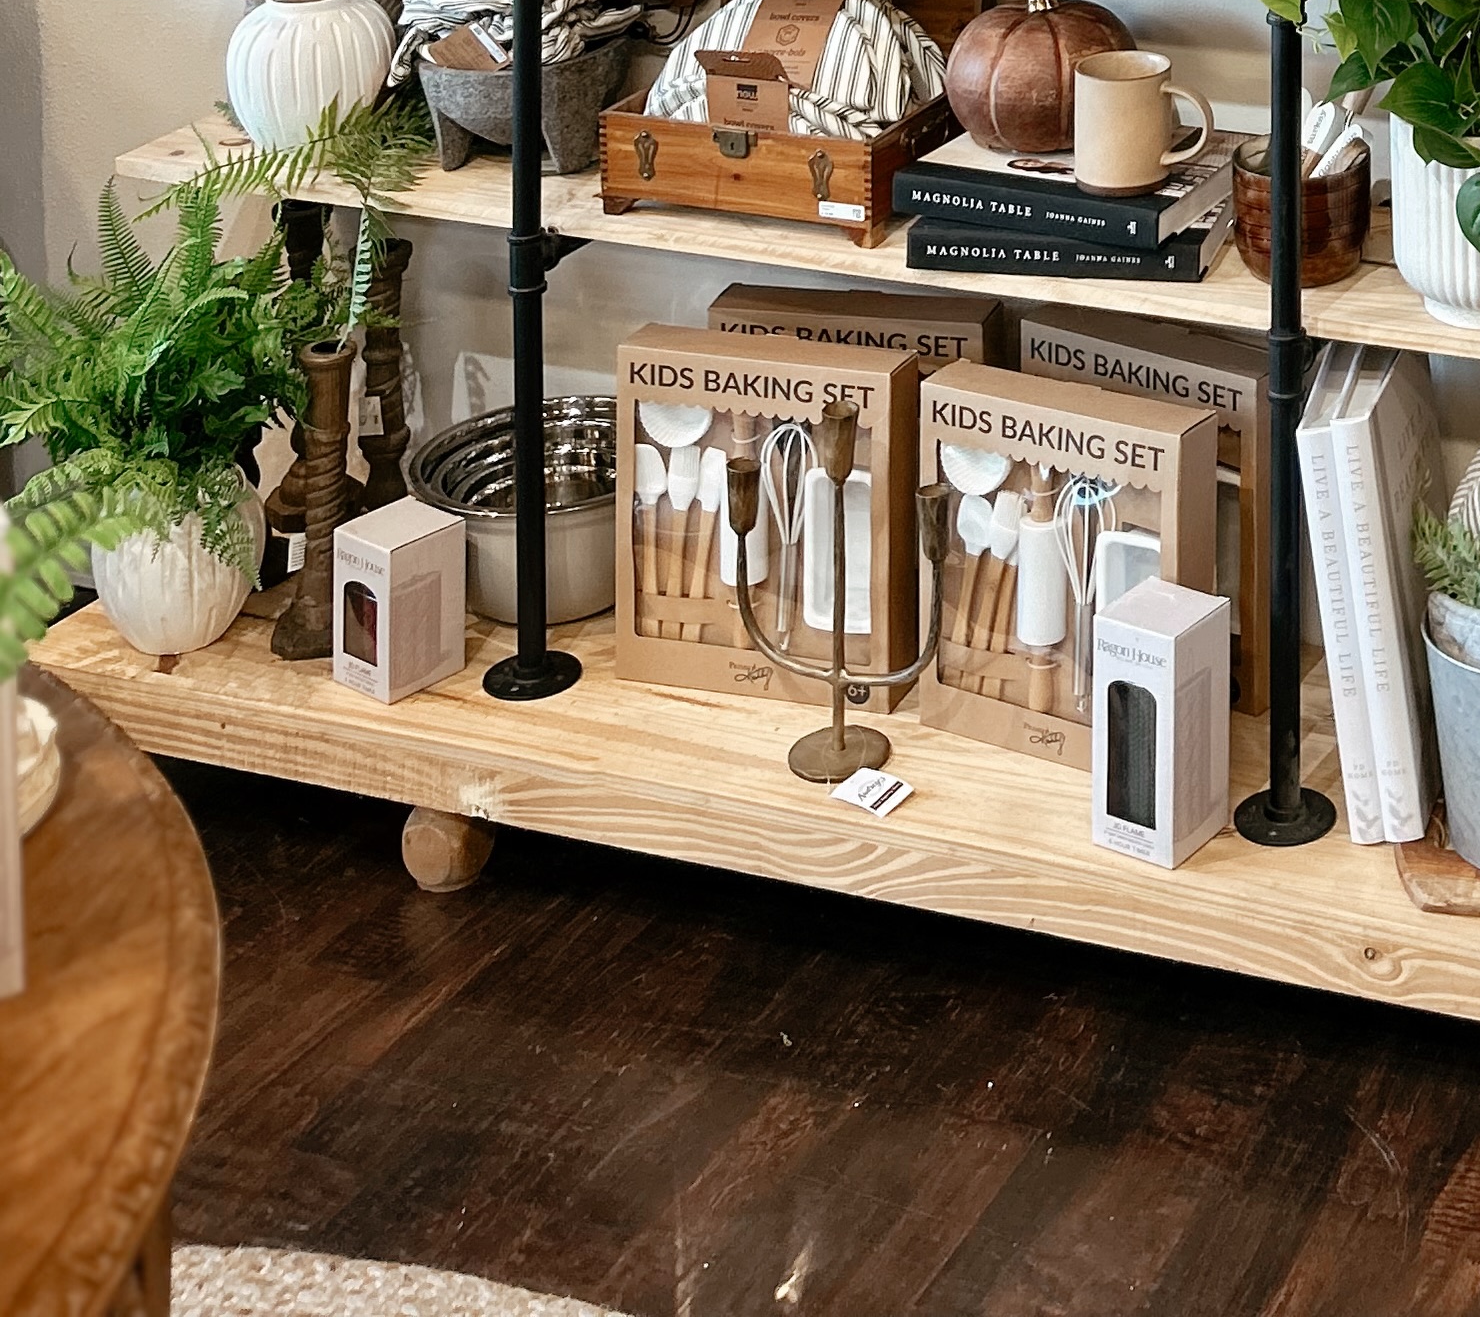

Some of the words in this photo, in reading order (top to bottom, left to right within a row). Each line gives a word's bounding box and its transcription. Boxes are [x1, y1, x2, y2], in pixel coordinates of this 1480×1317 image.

[911, 190, 984, 211] MAGNOLIA
[989, 201, 1033, 218] TABLE
[1045, 211, 1075, 225] JOANNA
[1076, 215, 1106, 228] GAINES
[926, 245, 1007, 260] MAGNOLIA
[1013, 249, 1061, 263] TABLE
[1075, 253, 1108, 264] JOANNA
[1110, 255, 1141, 266] GAINES
[917, 334, 969, 359] SET
[1031, 337, 1087, 372] KIDS
[1094, 354, 1192, 400] BAKING
[1198, 379, 1245, 413] SET
[629, 361, 695, 391] KIDS
[703, 368, 814, 405] BAKING
[822, 381, 876, 409] SET
[932, 399, 994, 435] KIDS
[1002, 415, 1108, 460] BAKING
[1115, 439, 1167, 472] SET
[1308, 453, 1330, 499] LIVE
[1320, 530, 1353, 644] BEAUTIFUL
[1337, 650, 1357, 699] LIFE
[1344, 444, 1364, 490] LIVE
[1355, 523, 1388, 644] BEAUTIFUL
[1372, 646, 1391, 693] LIFE
